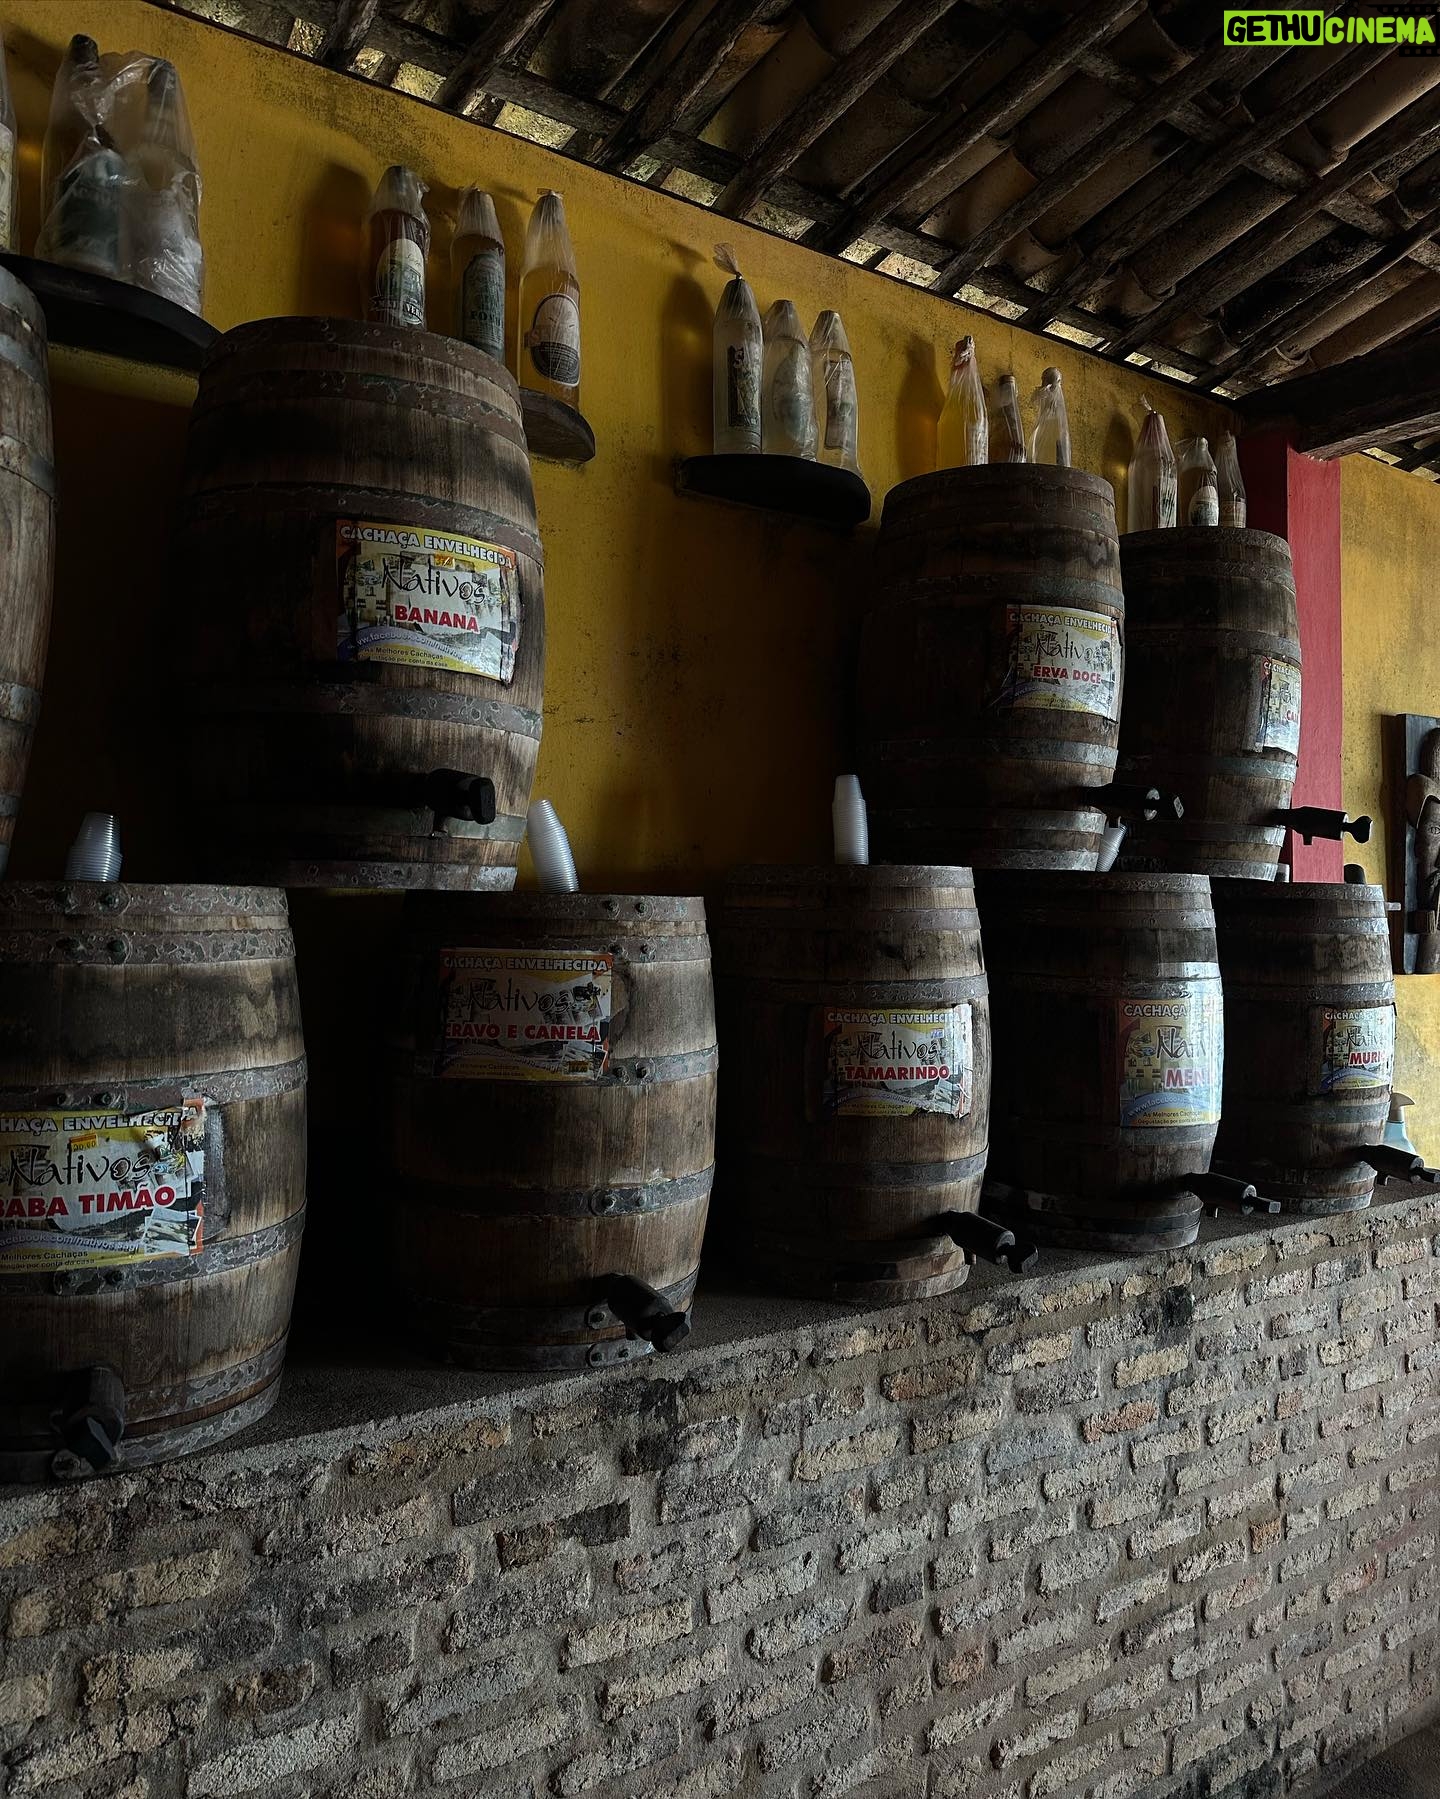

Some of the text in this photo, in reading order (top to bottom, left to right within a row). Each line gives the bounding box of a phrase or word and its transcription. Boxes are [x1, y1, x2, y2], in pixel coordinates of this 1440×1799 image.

[341, 525, 421, 549] CACHAÇA
[424, 534, 512, 569] ENVELHECIDA
[381, 556, 486, 605] Nativos
[394, 605, 479, 632] BANANA
[1009, 612, 1062, 627] CACHAÇA
[1033, 665, 1102, 685] ERVA DOCE
[444, 955, 608, 972] CACHAÇA ENVELHECIDA
[827, 1012, 886, 1027] CACHAÇA
[1124, 1004, 1188, 1020] CACHAÇA
[507, 1024, 517, 1039] E
[525, 1025, 600, 1041] CANELA
[857, 1030, 938, 1060] Nativos
[1349, 1051, 1384, 1065] MURI
[845, 1066, 950, 1080] TAMARINDO
[1166, 1069, 1210, 1088] MEN
[9, 1141, 150, 1187] Nativos
[0, 1183, 175, 1218] ABA TIMÃO
[43, 1250, 88, 1260] Cachaças
